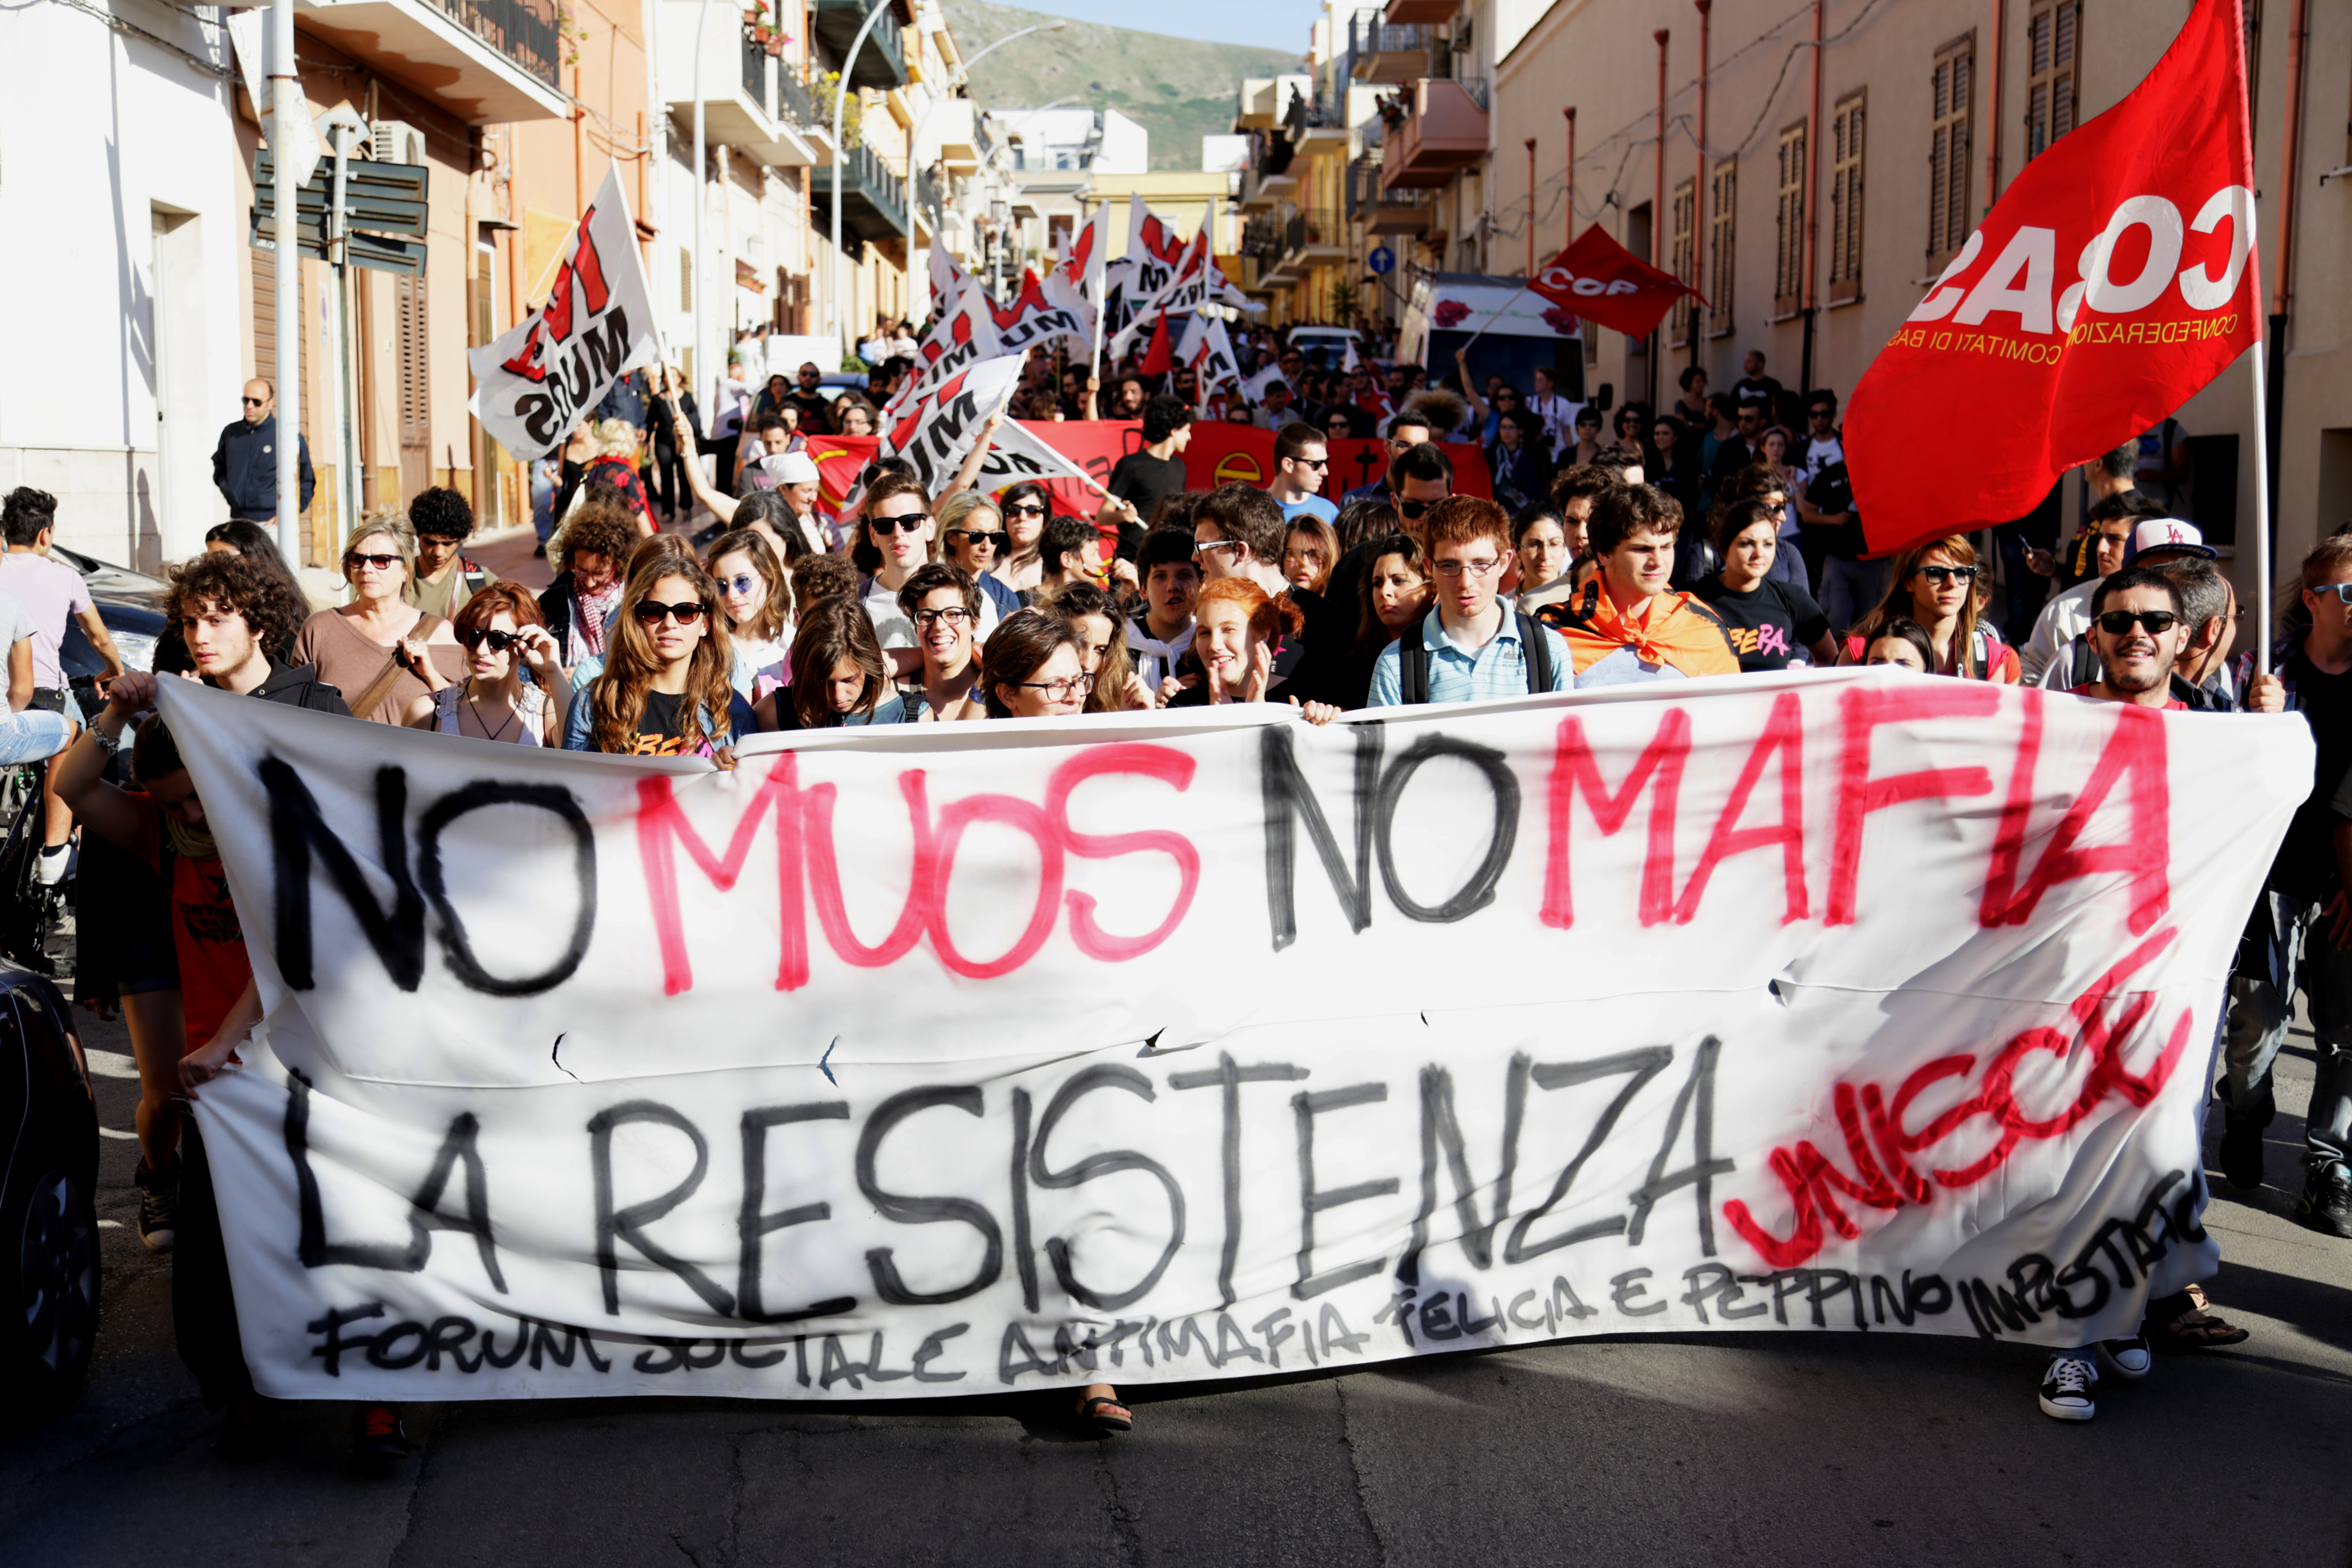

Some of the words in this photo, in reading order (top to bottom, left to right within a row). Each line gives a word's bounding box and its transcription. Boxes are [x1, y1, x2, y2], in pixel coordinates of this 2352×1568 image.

[2166, 524, 2184, 543] LA
[2172, 546, 2211, 557] ANGELES
[1728, 623, 1791, 657] BERA
[258, 753, 597, 997] NO
[636, 742, 1200, 996] MUOS
[1260, 720, 1521, 953] NO
[1540, 683, 2170, 937] MAFIA
[283, 1067, 509, 1294] LA
[588, 1035, 1735, 1322] RESISTENZA
[307, 1302, 610, 1377] FORUM
[634, 1322, 971, 1391] SOCIALE
[999, 1302, 1370, 1385] ANTIMAFIA
[1374, 1276, 1598, 1348] FELICIA
[1609, 1267, 1667, 1316] E
[1681, 1261, 1953, 1331] PEPPINO
